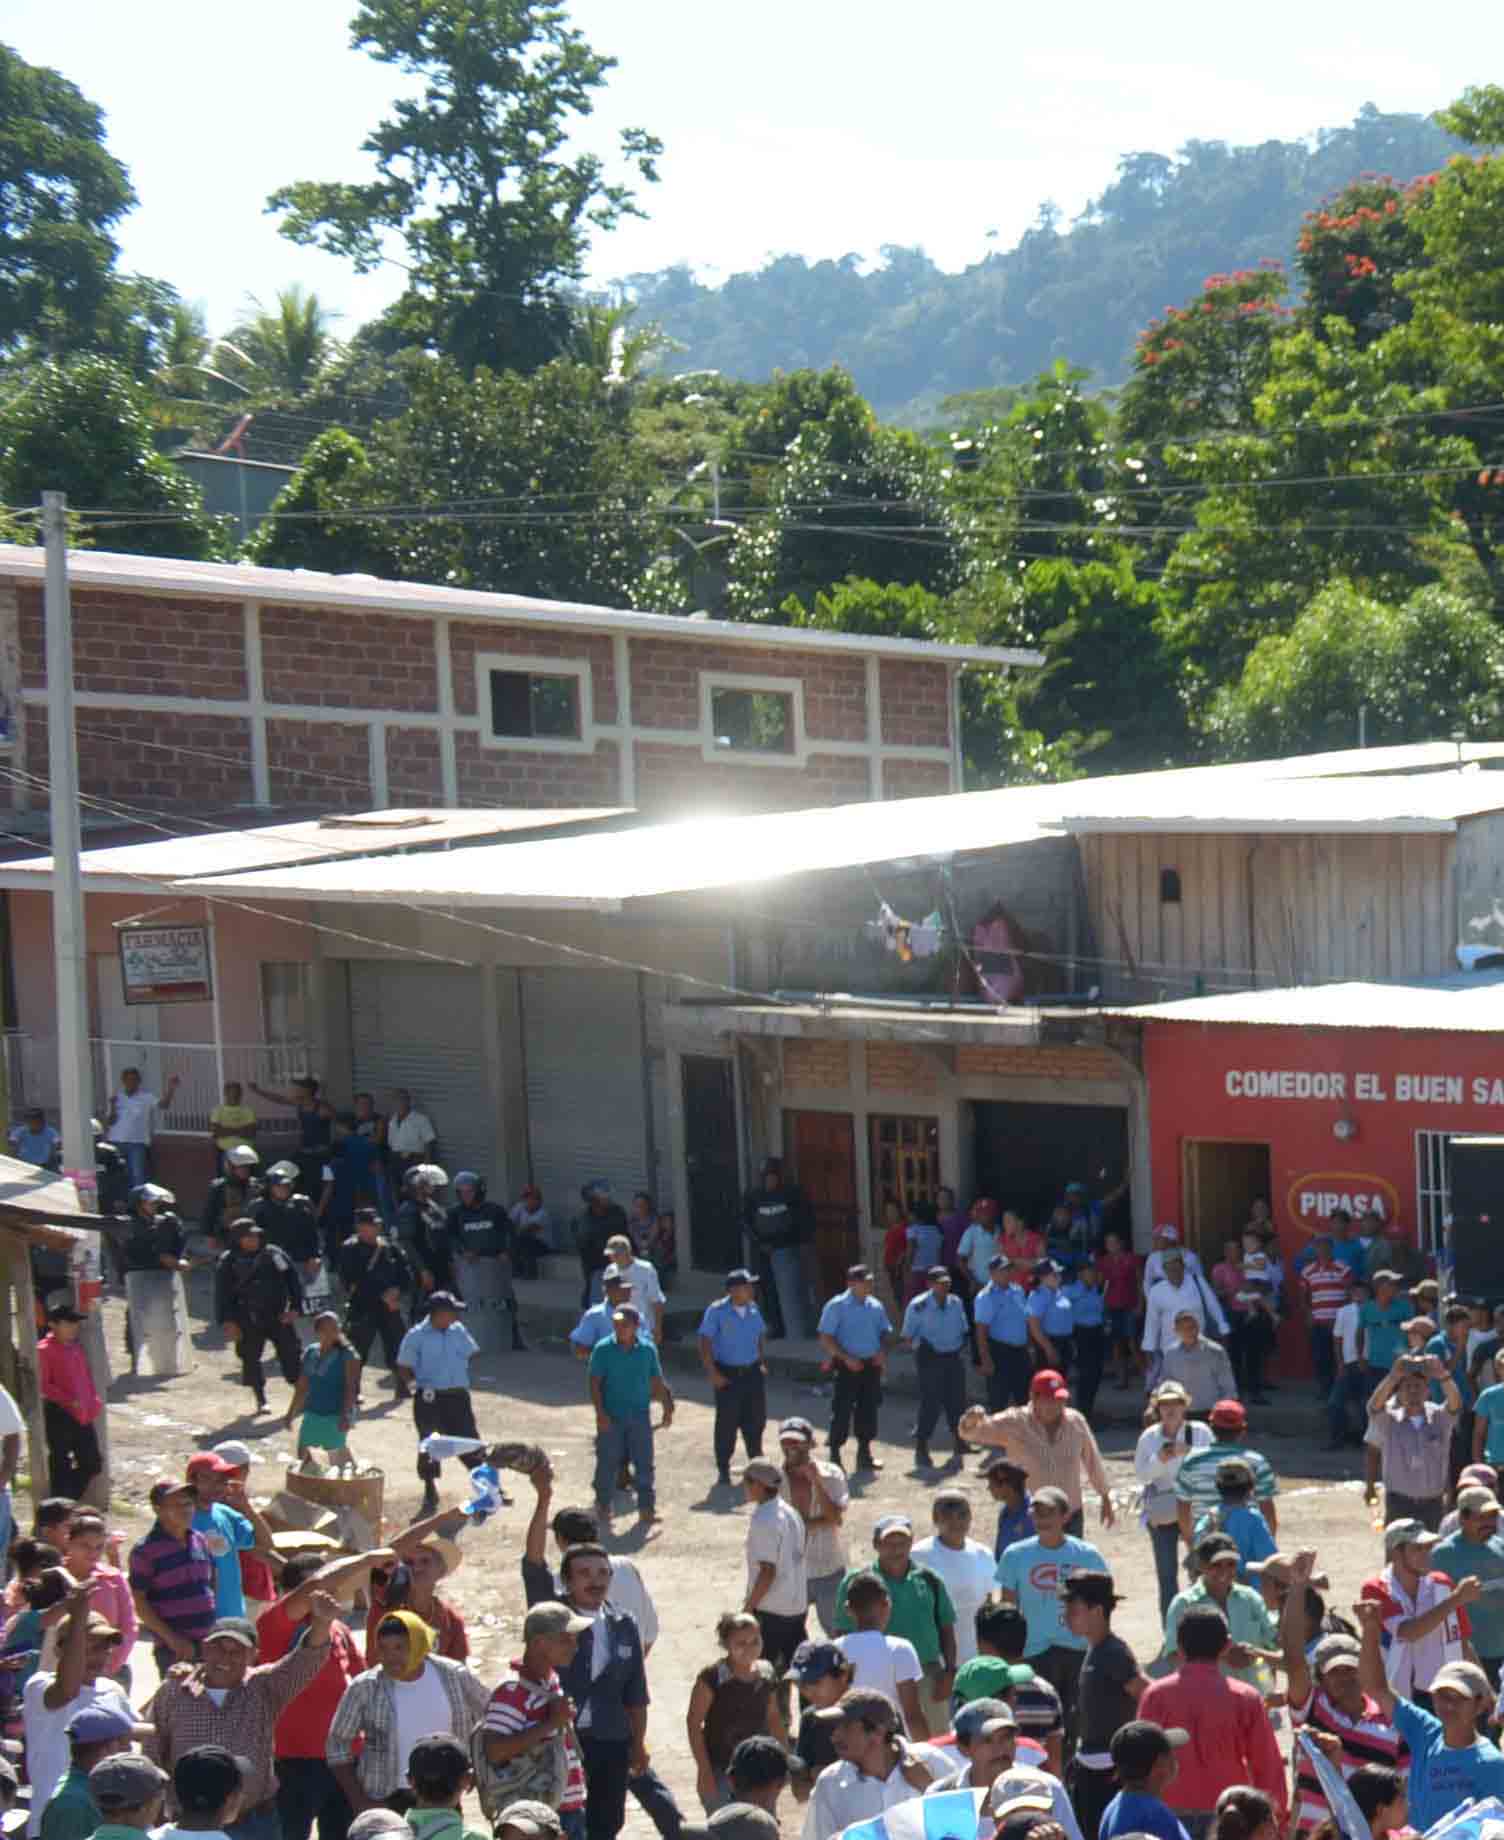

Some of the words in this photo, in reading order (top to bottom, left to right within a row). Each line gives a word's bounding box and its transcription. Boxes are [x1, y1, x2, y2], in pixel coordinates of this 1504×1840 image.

[1226, 1071, 1346, 1099] COMEDOR
[1354, 1073, 1386, 1101] EL
[1395, 1075, 1463, 1104] BUEN
[1300, 1190, 1385, 1219] PIPASA
